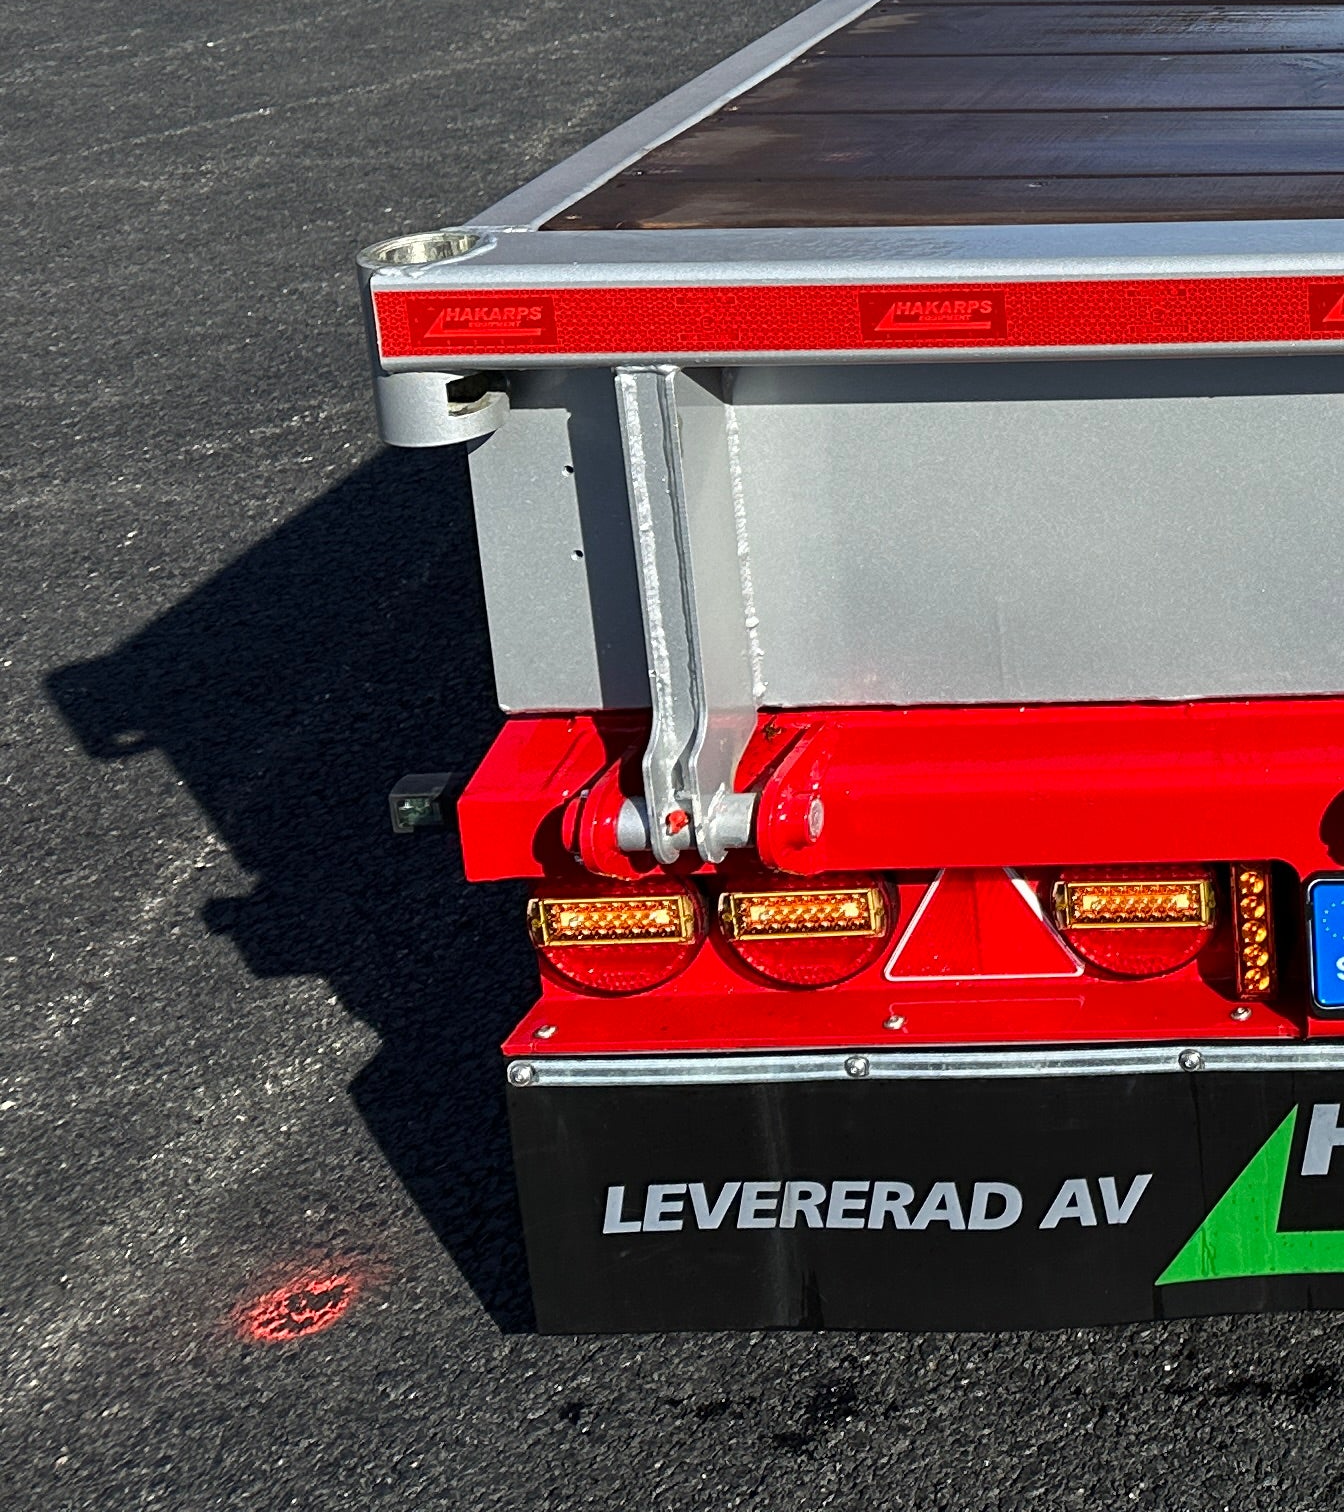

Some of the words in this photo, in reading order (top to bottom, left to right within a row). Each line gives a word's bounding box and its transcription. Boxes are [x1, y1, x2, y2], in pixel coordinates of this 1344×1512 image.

[445, 306, 542, 321] HAKARPS
[896, 299, 993, 315] HAKARPS
[602, 1180, 1023, 1234] LEVERERAD
[1039, 1173, 1153, 1230] AV
